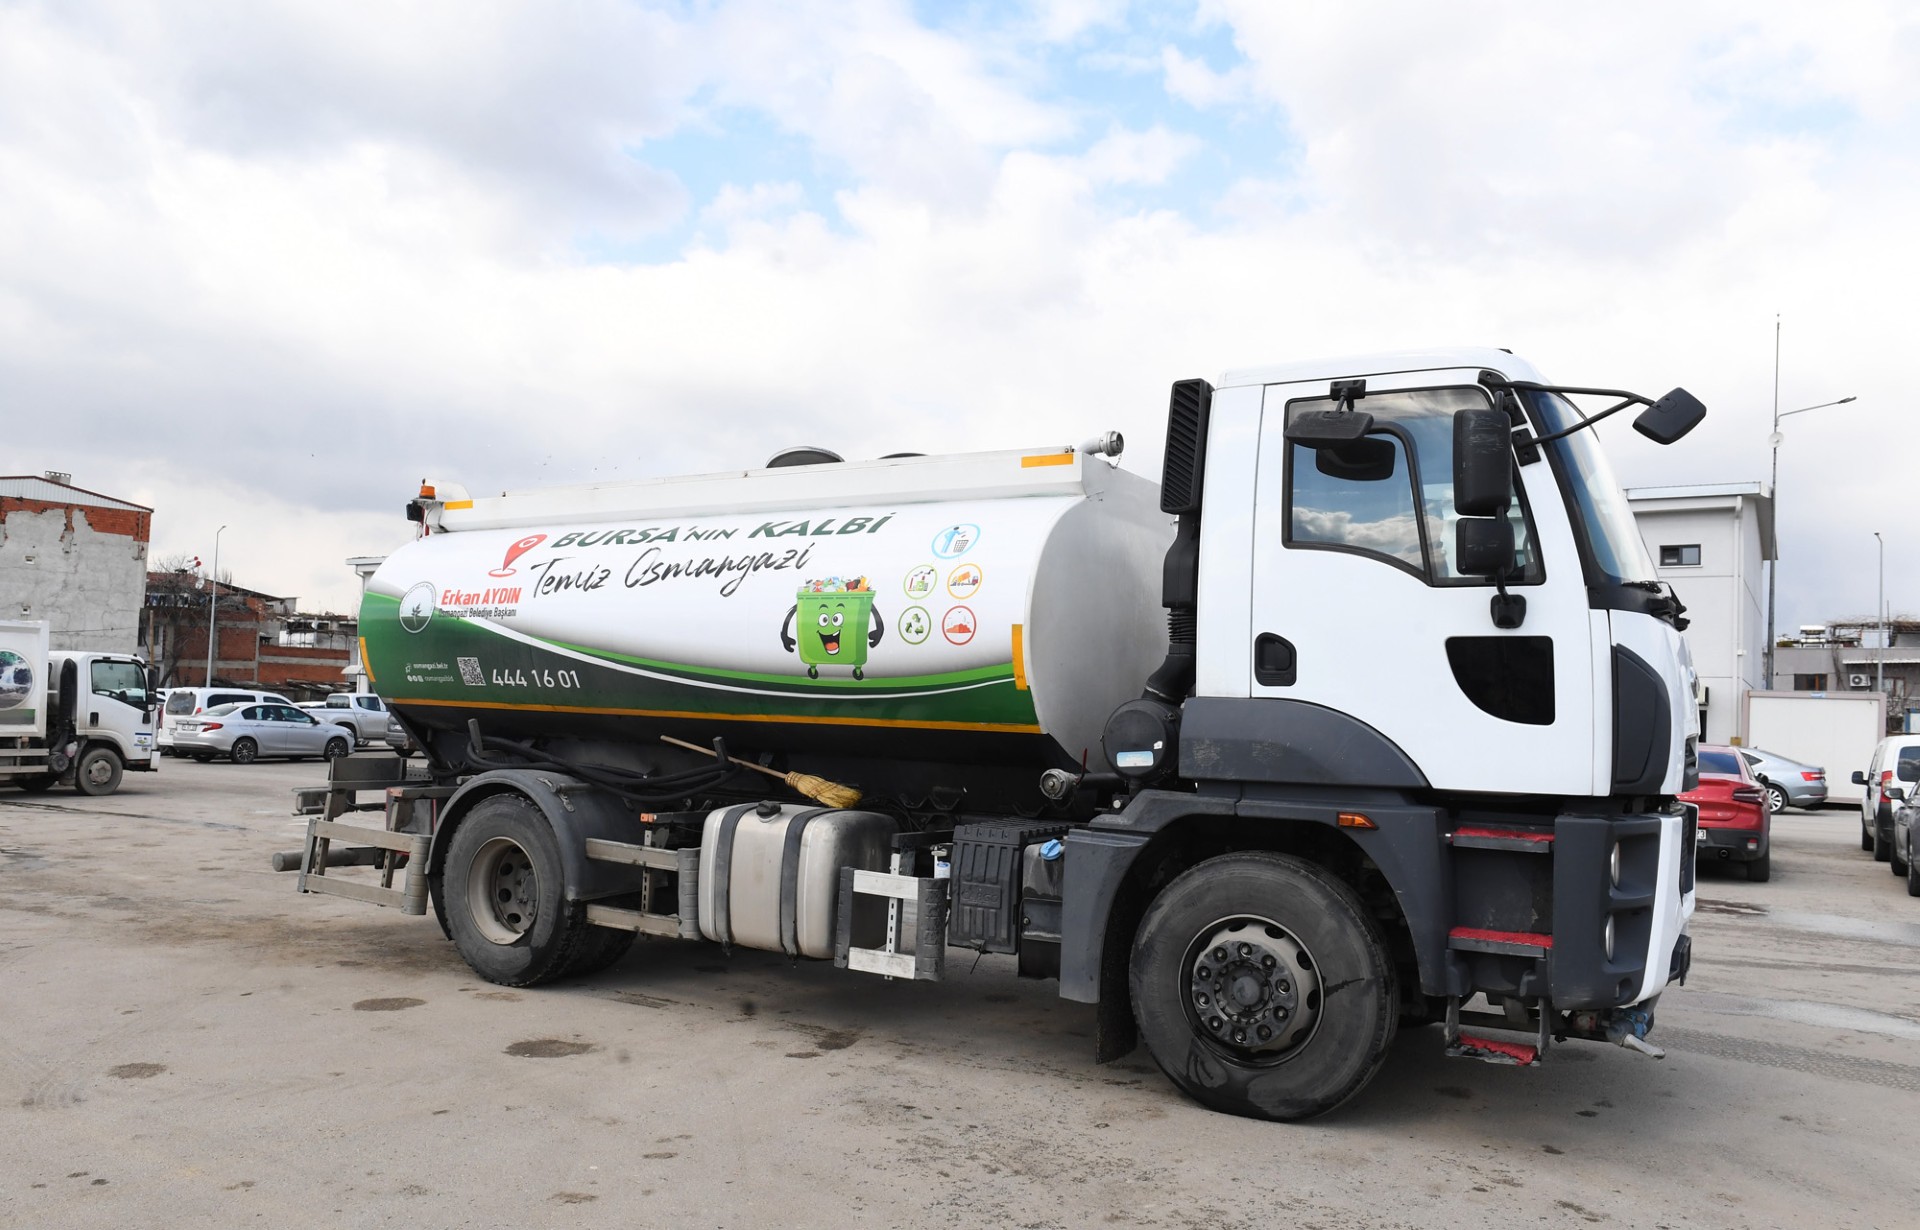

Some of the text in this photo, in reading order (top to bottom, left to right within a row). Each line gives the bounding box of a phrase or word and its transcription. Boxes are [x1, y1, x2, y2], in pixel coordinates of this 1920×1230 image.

[550, 512, 897, 548] BURSA'NIN KALBİ
[531, 542, 815, 598] Temiz Osmangazi
[441, 589, 480, 605] Erkan
[481, 587, 522, 605] AYDIN
[439, 607, 517, 620] Osmangazi Belediye Başkanı
[492, 668, 581, 688] 444 16 01
